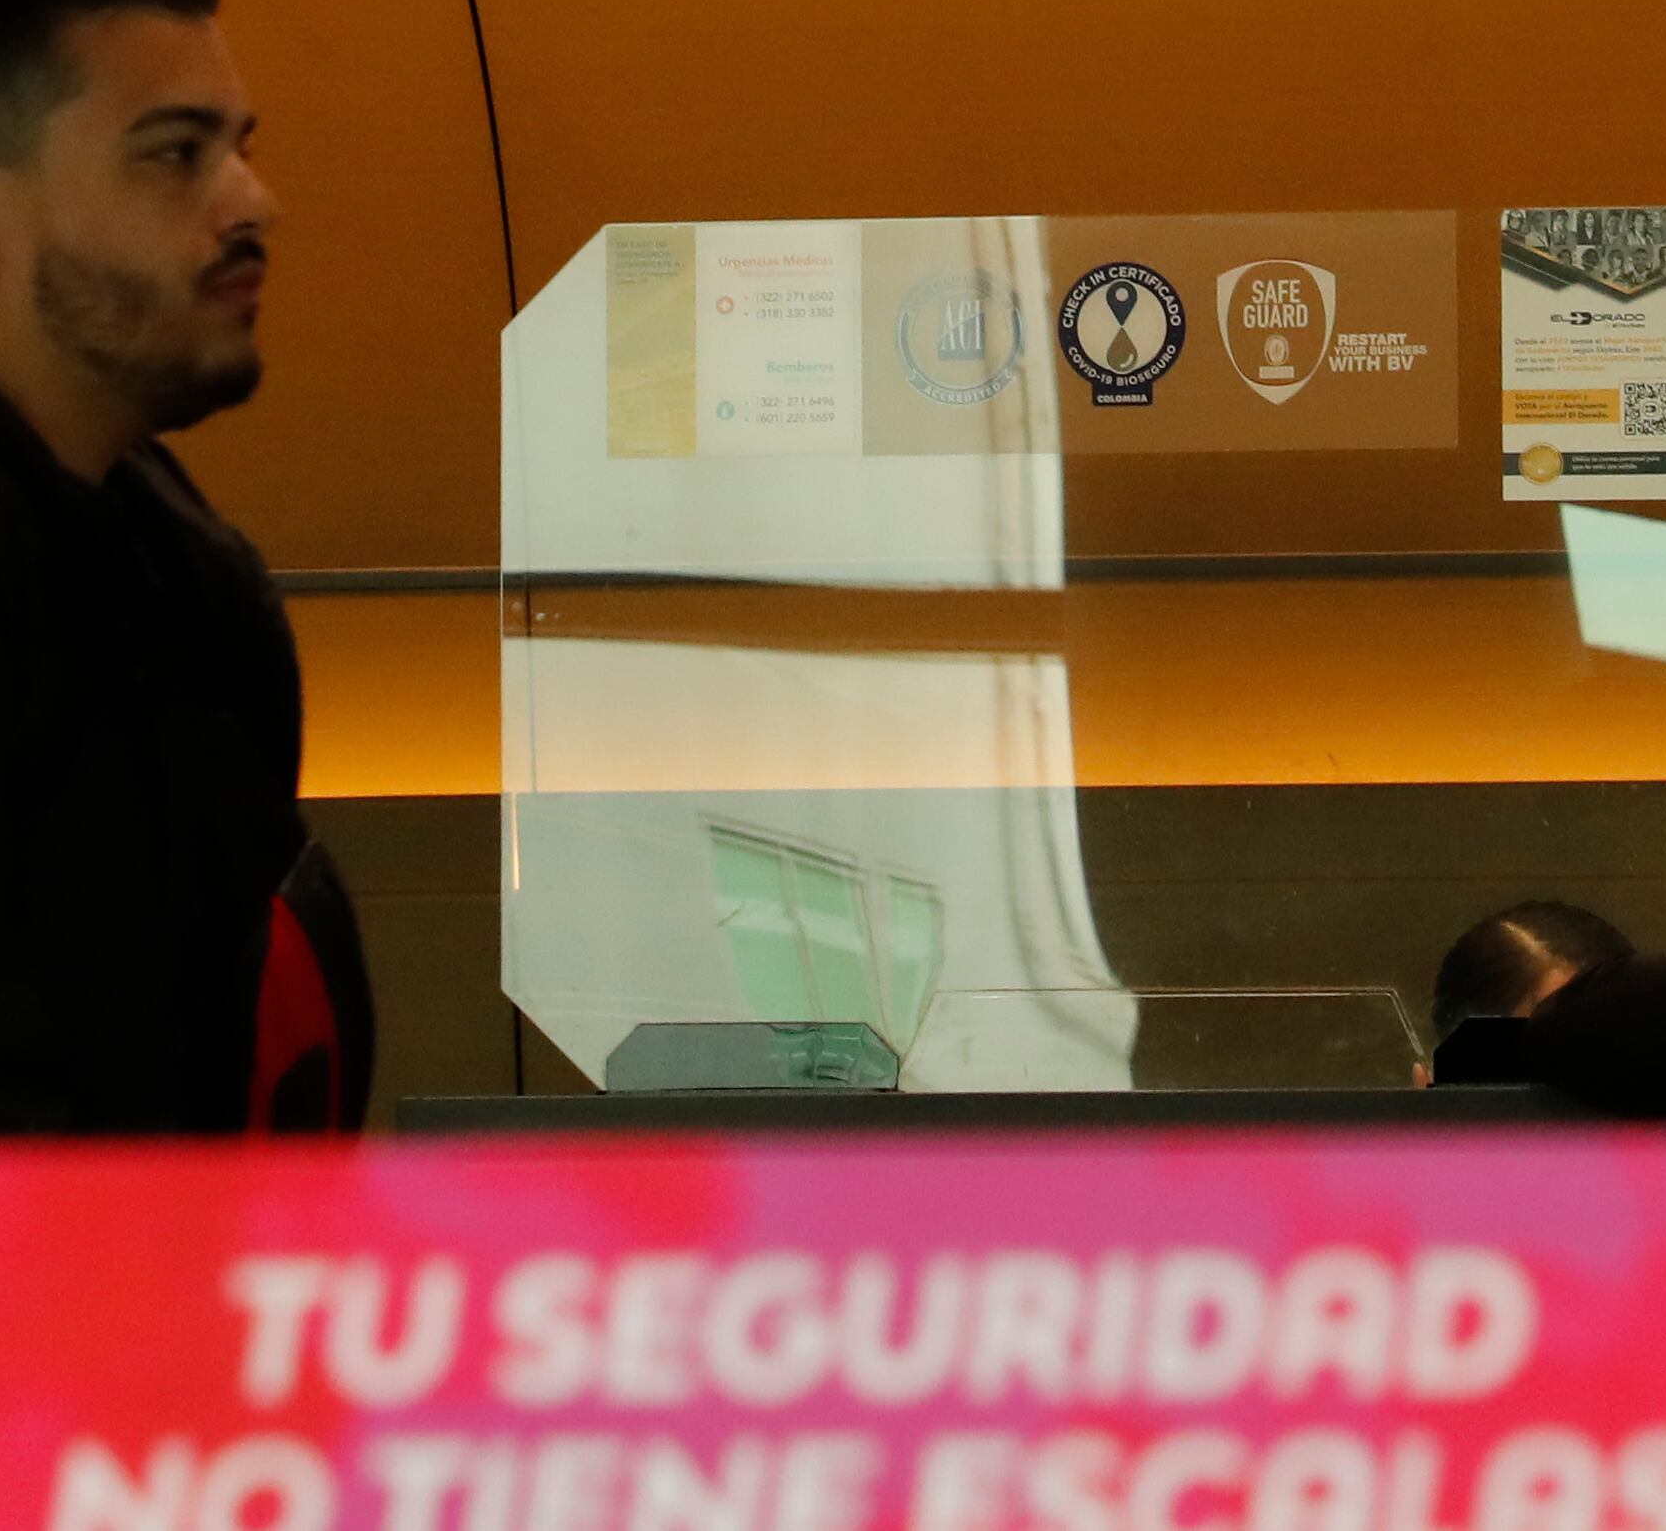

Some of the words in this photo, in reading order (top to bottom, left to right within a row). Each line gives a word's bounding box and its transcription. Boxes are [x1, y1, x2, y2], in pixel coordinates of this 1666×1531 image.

[718, 255, 779, 270] Urgencias
[786, 292, 805, 302] 271
[808, 291, 834, 301] 6502
[1062, 281, 1091, 328] CHECK
[1089, 270, 1107, 286] IN
[1108, 266, 1182, 327] CERTIFICADO
[1251, 279, 1301, 304] SAFE
[940, 299, 982, 351] ACI
[1243, 303, 1309, 329] GUARD
[1333, 345, 1367, 356] YOUR
[1369, 344, 1428, 356] BUSINESS
[1337, 333, 1408, 346] RESTART
[1068, 346, 1113, 385] COVID-19
[1116, 345, 1176, 386] BIOSEGURO
[1328, 355, 1381, 373] WITH
[1387, 355, 1415, 372] BV
[1096, 394, 1149, 404] COLOMBIA
[225, 1254, 465, 1408] TU
[490, 1249, 1537, 1407] SEGURIDAD
[47, 1431, 336, 1531] NO
